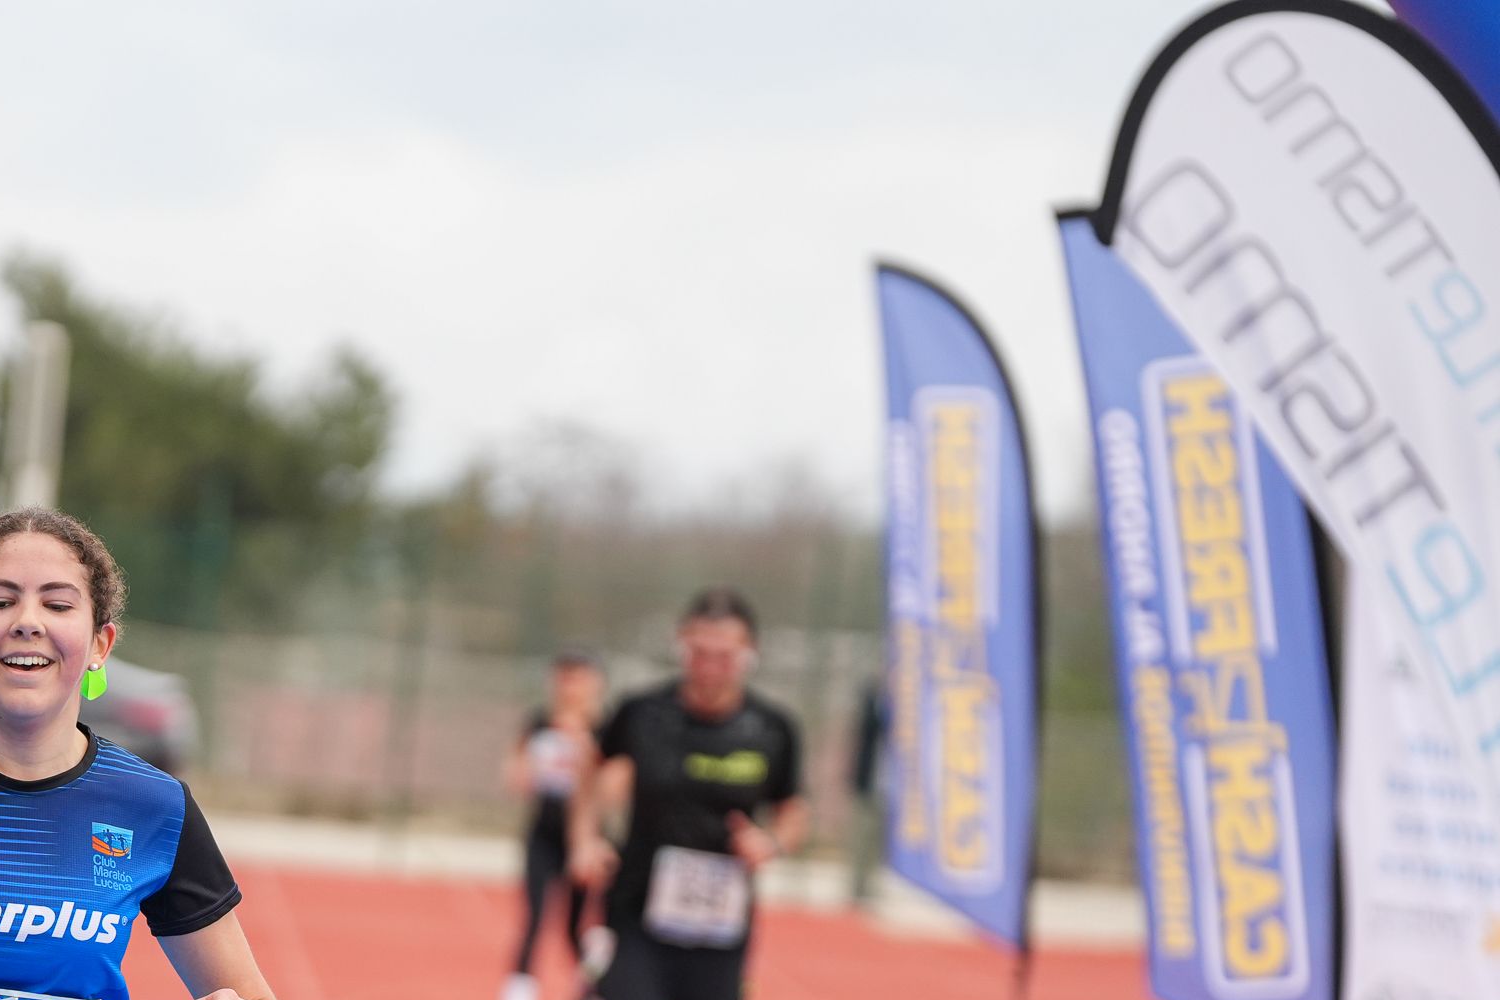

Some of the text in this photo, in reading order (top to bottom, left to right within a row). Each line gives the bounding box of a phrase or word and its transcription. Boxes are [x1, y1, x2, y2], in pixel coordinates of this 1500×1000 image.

[92, 854, 116, 869] Club
[93, 864, 133, 883] Maratón
[94, 876, 133, 891] Lucena
